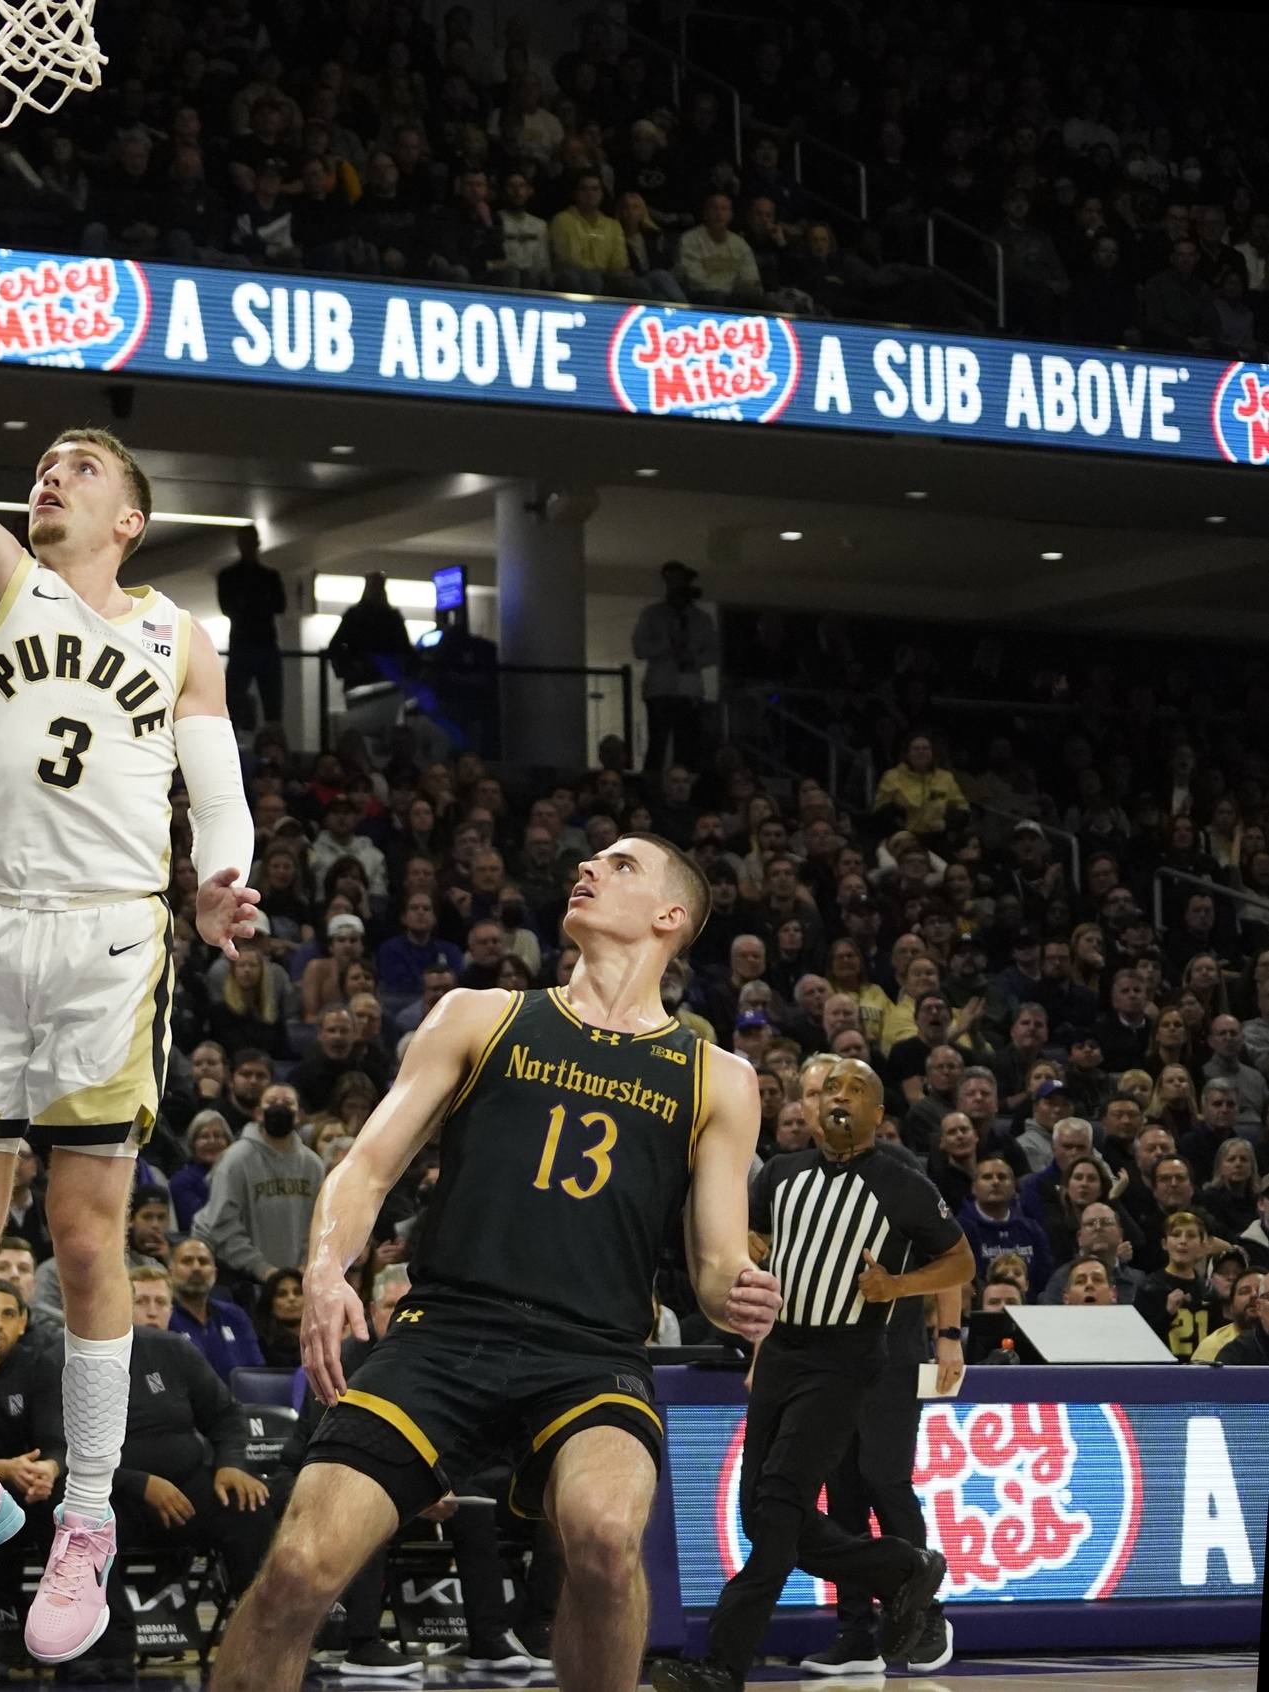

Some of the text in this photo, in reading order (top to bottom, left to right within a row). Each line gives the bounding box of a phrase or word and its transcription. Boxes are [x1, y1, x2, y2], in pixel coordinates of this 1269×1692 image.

[164, 279, 578, 392] A SUB ABOVE
[635, 320, 768, 362] Jersey
[652, 356, 774, 411] Mike's
[813, 335, 852, 414] A
[872, 338, 981, 424] SUB
[1004, 353, 1181, 443] ABOVE
[35, 715, 94, 791] 3
[504, 1043, 680, 1125] Northwestern
[532, 1103, 619, 1200] 13
[1168, 1308, 1209, 1357] 21
[145, 1372, 166, 1395] N
[249, 1418, 265, 1437] N
[912, 1406, 1069, 1486] sey
[935, 1481, 1085, 1587] ke's
[1182, 1416, 1257, 1587] A
[136, 1624, 178, 1633] HRMAN
